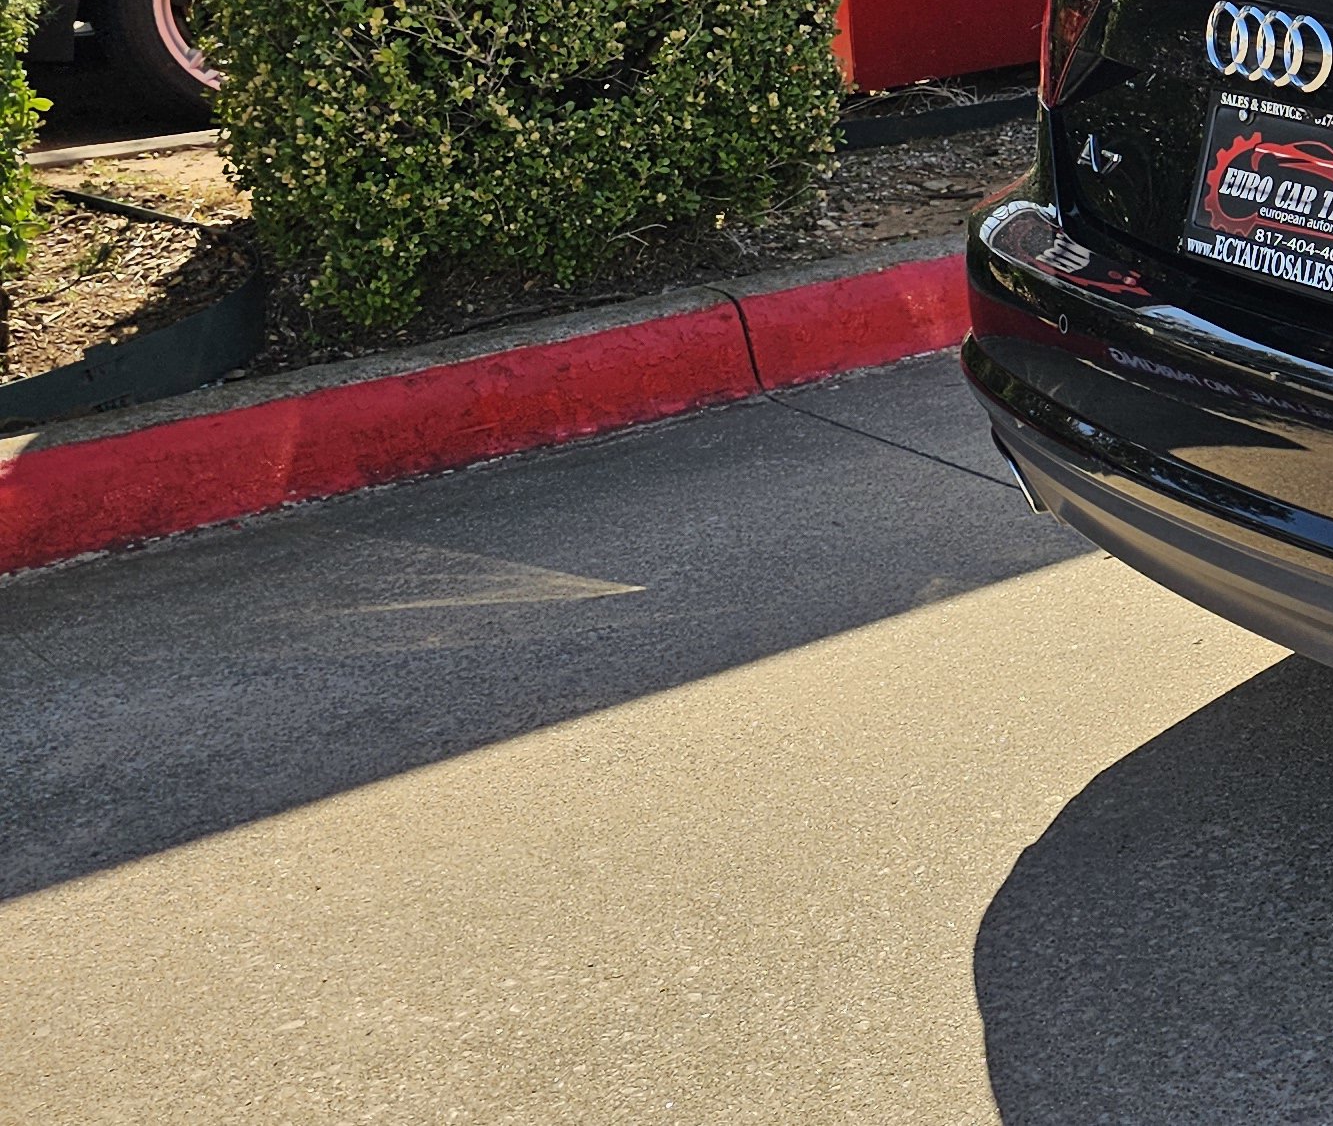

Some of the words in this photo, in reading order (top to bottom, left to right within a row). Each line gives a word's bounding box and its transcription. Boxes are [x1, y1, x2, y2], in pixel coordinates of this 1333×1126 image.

[1220, 91, 1250, 109] SALES
[1250, 98, 1259, 111] &
[1260, 100, 1304, 121] SERVICE
[1076, 133, 1123, 174] A7
[1218, 167, 1274, 203] EURO
[1274, 180, 1318, 215] CAR
[1259, 206, 1306, 226] european
